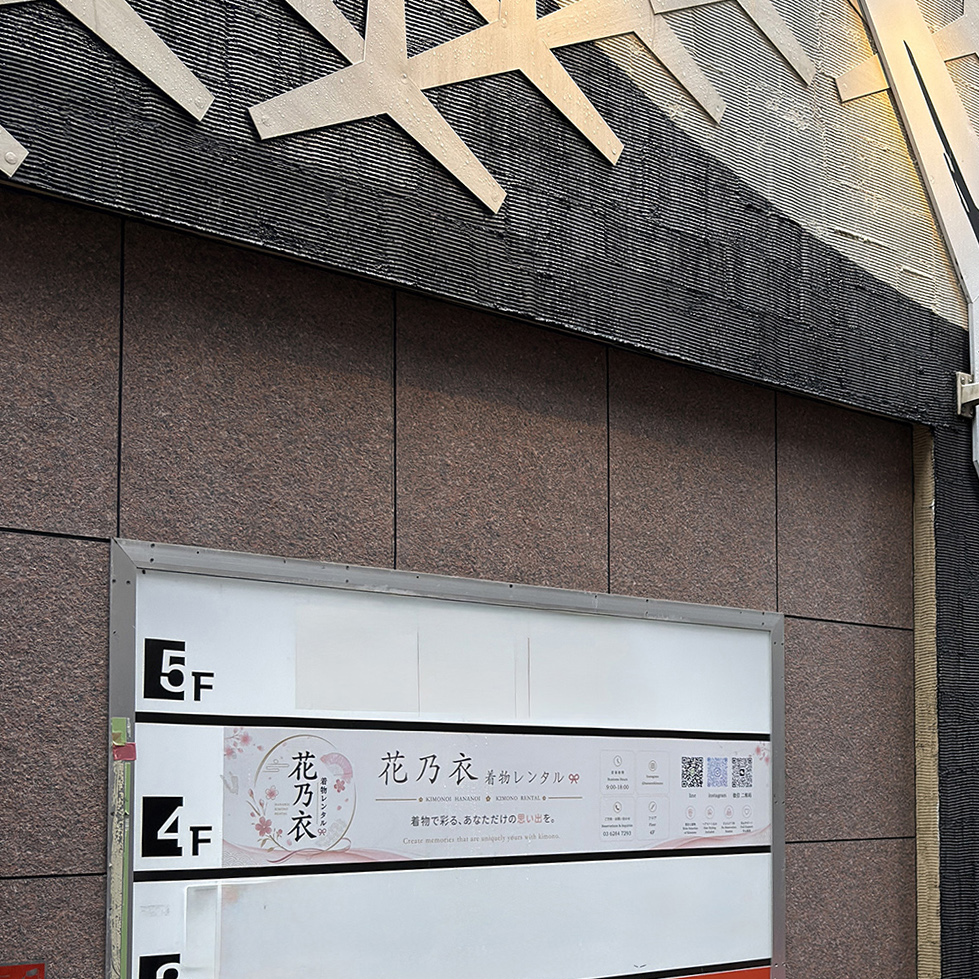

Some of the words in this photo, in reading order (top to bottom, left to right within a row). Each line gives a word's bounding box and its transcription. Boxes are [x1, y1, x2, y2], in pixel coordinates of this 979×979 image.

[154, 645, 214, 702] 5F
[378, 750, 479, 786] 花乃衣
[484, 769, 565, 786] 着物レンタル
[287, 750, 319, 842] 花乃衣
[319, 776, 328, 827] 着物レンタル
[411, 813, 555, 827] 着物で彩る、あなただけの思い出を。
[152, 802, 212, 856] 4F
[402, 837, 423, 845] Create
[425, 836, 455, 845] memories
[457, 835, 468, 843] that
